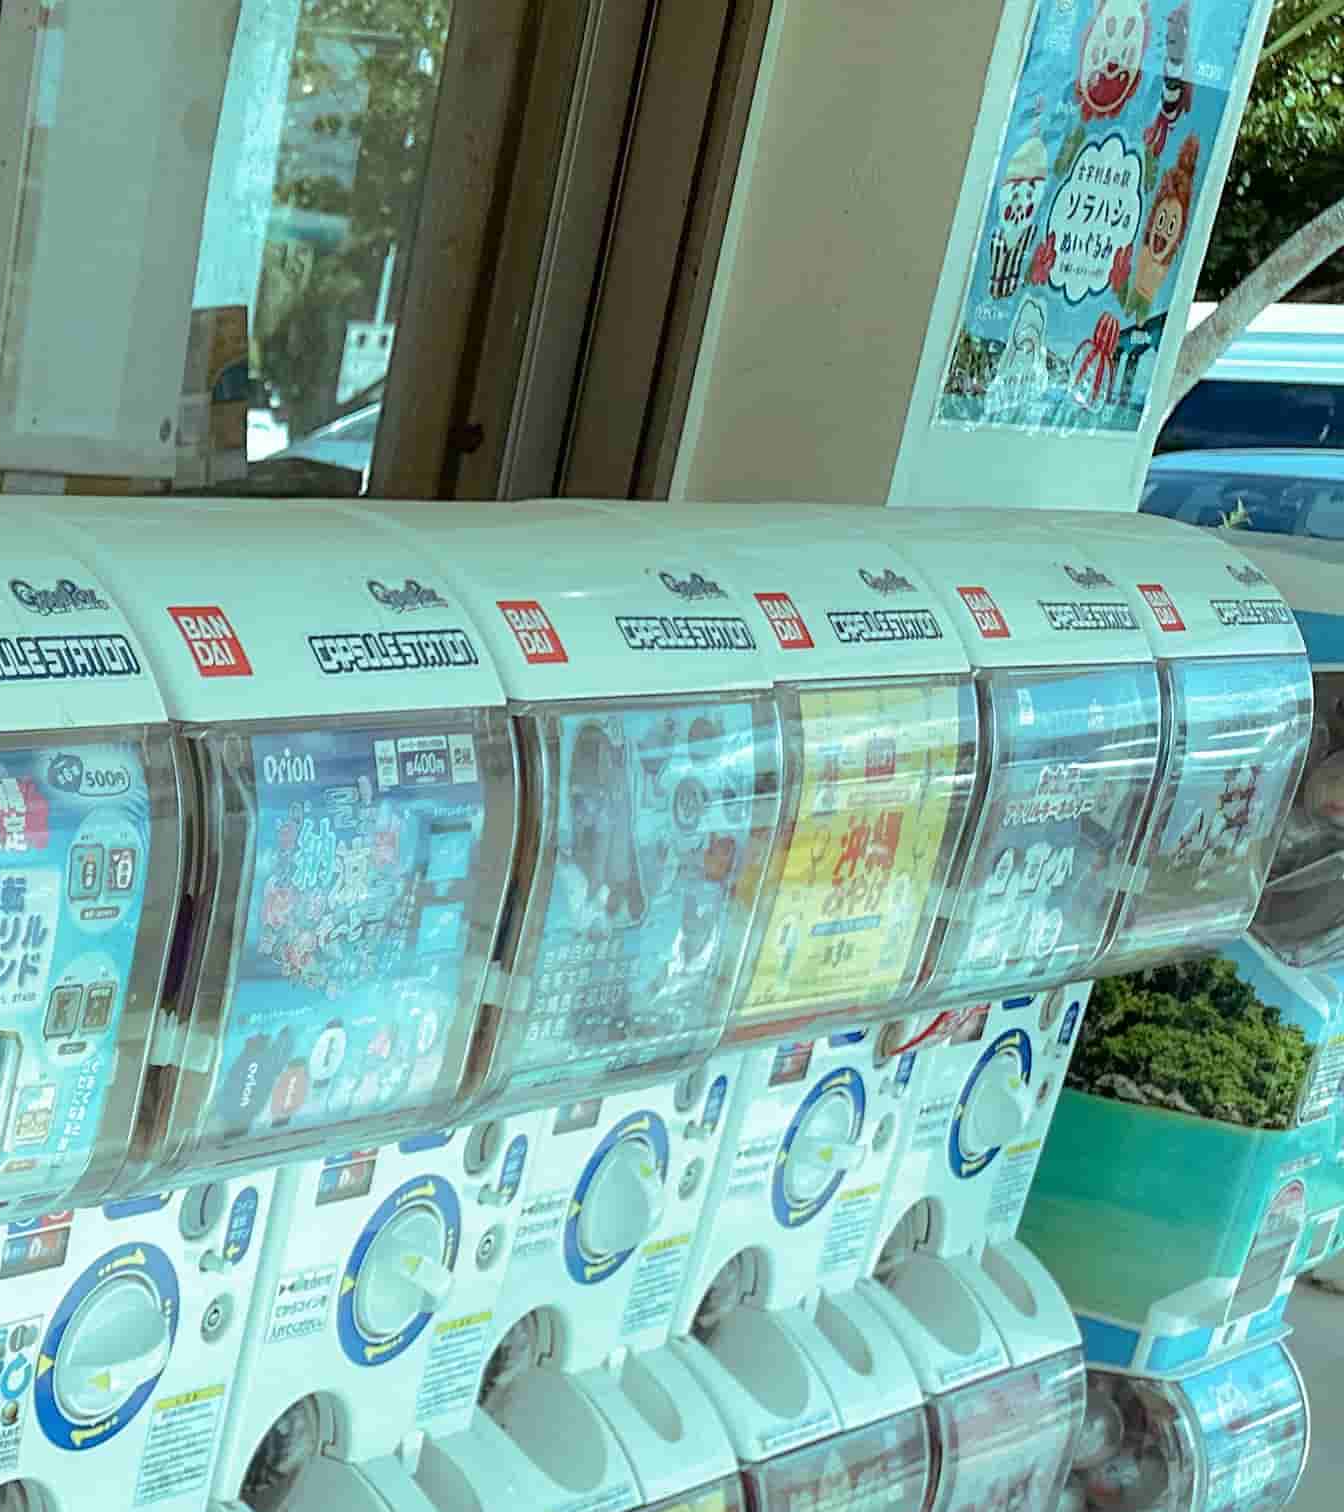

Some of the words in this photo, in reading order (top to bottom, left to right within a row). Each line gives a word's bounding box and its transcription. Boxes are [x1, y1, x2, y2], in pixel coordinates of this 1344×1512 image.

[180, 616, 232, 640] BAN
[193, 641, 236, 667] DAI
[263, 747, 314, 784] Orion
